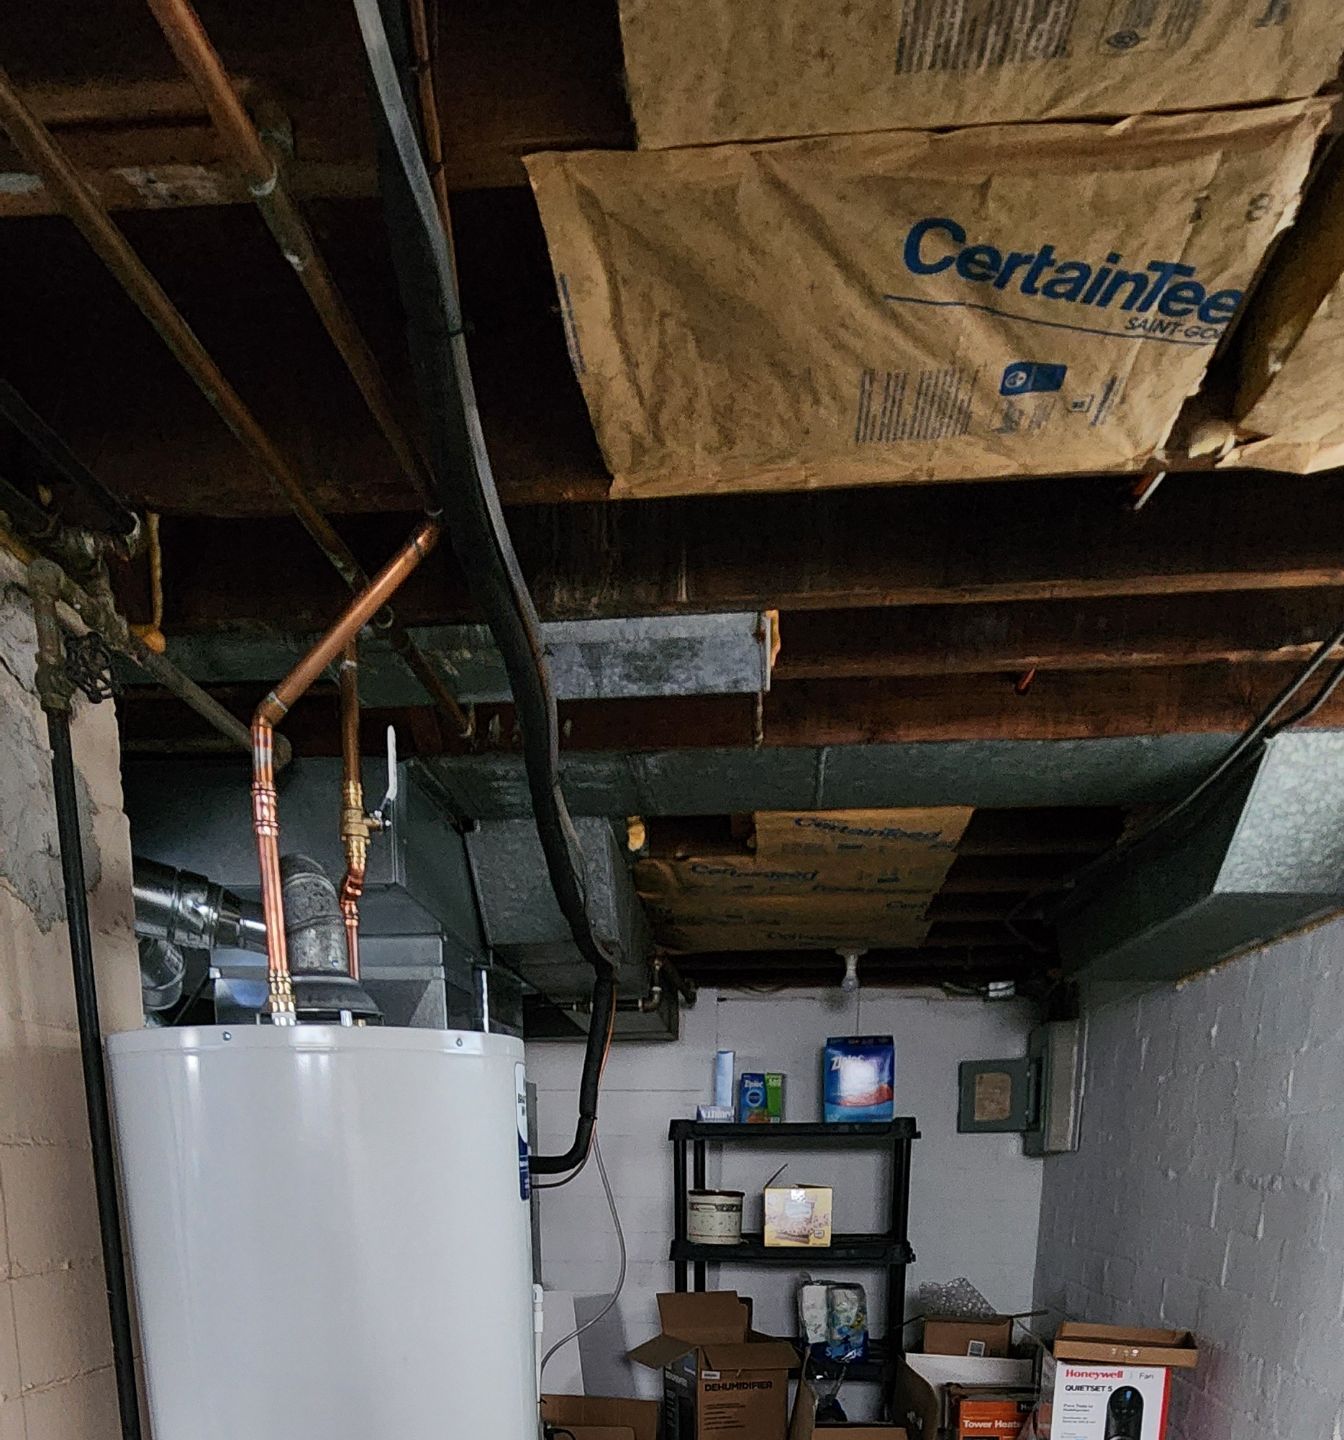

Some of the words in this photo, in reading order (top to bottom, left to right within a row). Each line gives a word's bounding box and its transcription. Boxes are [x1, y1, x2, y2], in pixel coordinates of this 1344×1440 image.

[903, 217, 1244, 325] CertainTee
[1065, 1369, 1124, 1380] Honeywell
[1139, 1372, 1154, 1380] Fan
[704, 1380, 773, 1392] DEHUMIDIFIER
[1065, 1384, 1106, 1392] QUIETSET
[962, 1419, 993, 1429] Tower
